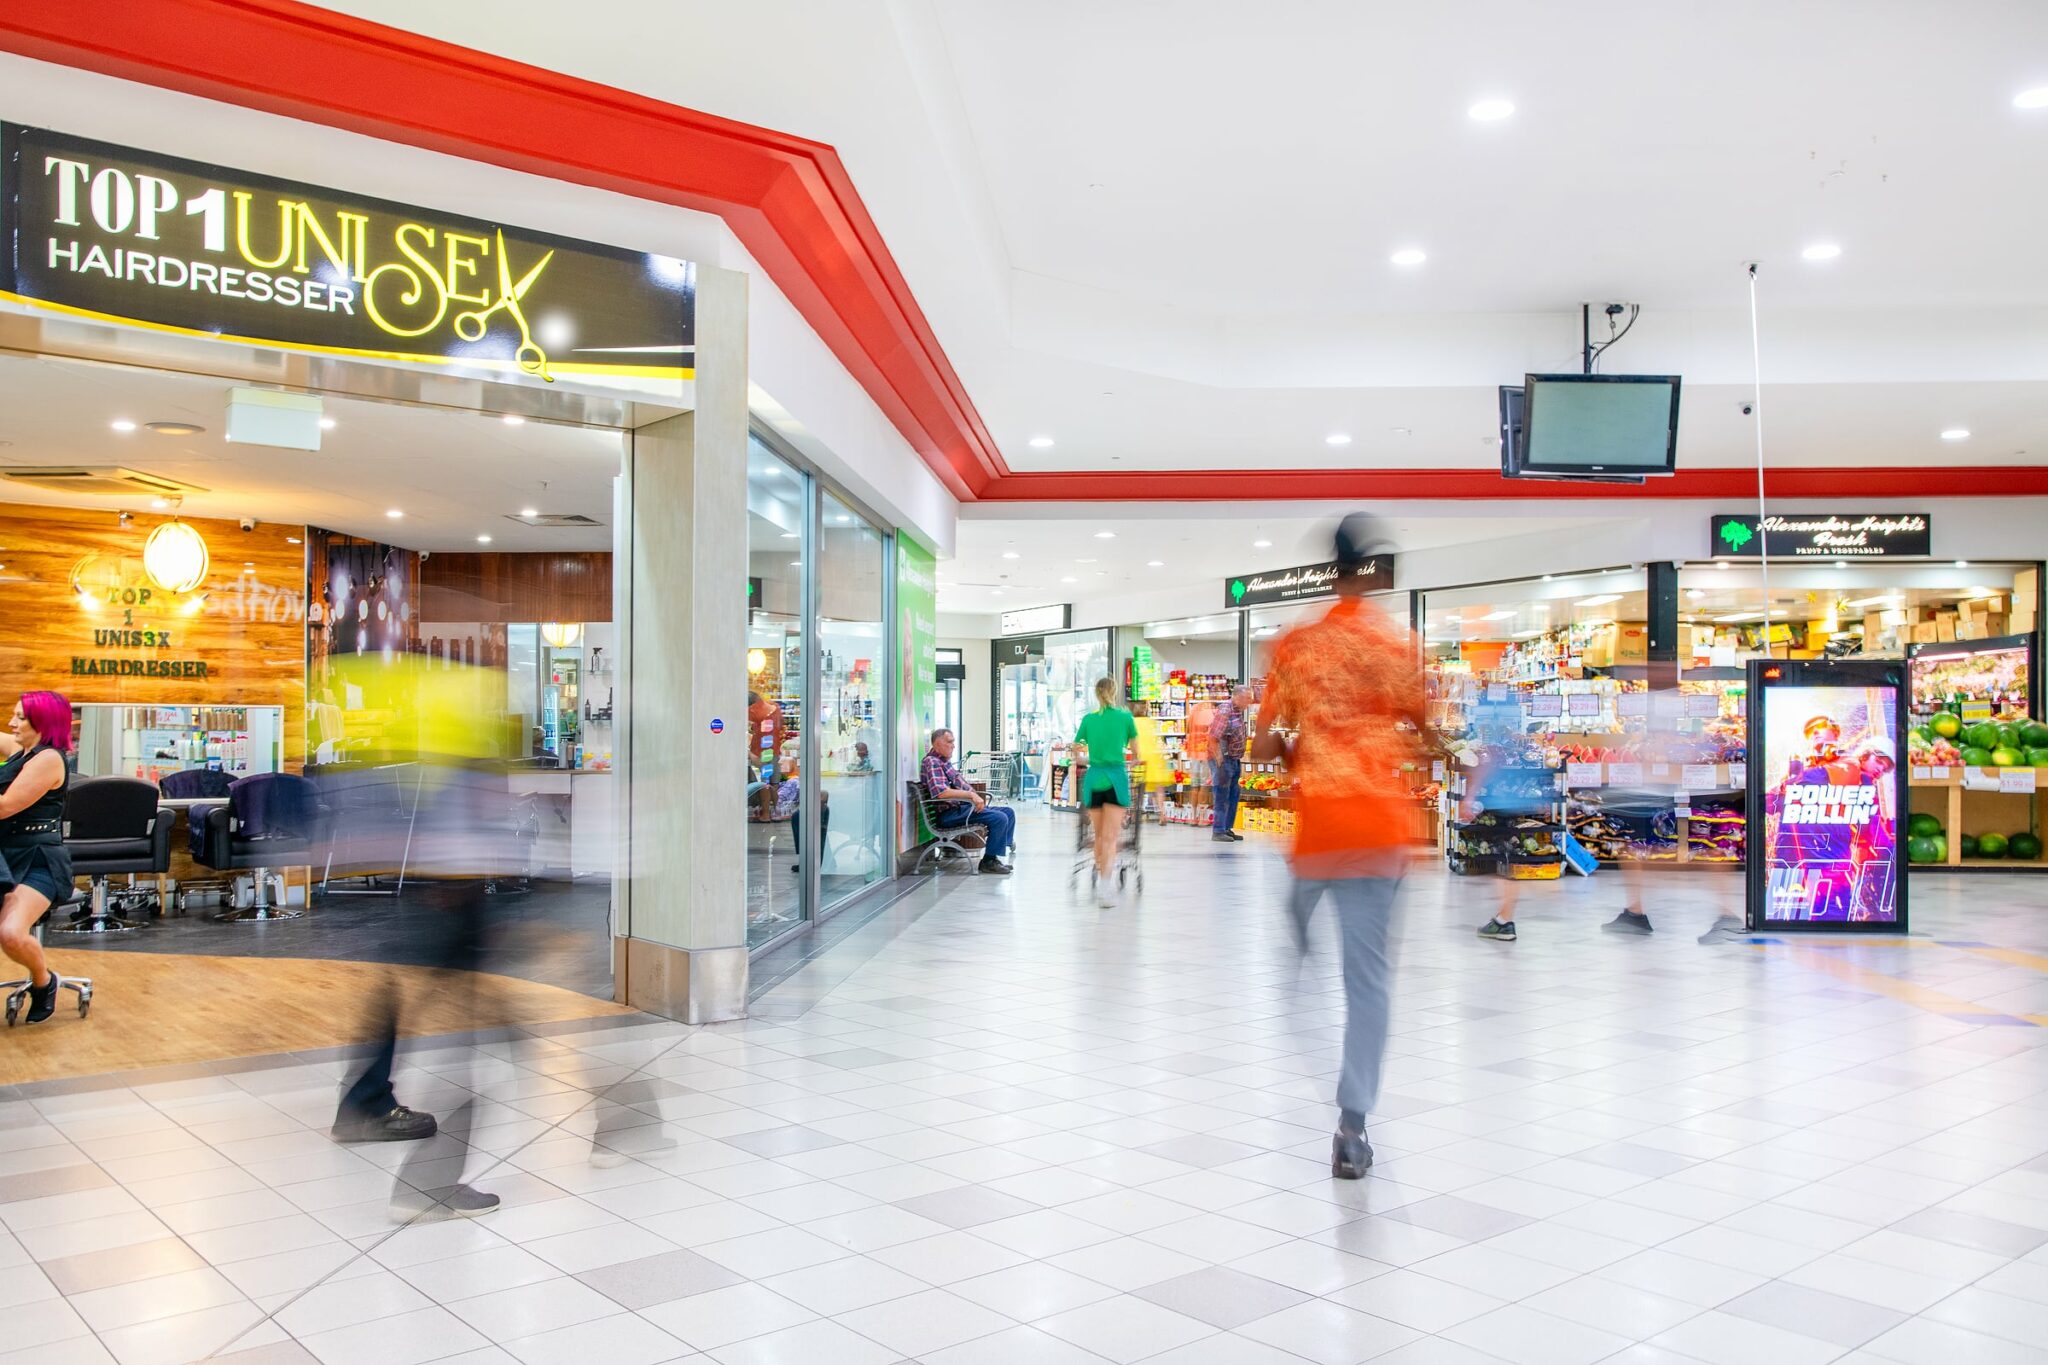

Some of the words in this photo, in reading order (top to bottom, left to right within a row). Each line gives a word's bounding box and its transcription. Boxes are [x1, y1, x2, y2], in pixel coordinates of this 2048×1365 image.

[45, 156, 179, 240] TOP
[48, 237, 356, 316] HAIRDRESSER
[1756, 516, 1850, 532] Alexander
[1851, 515, 1925, 536] Heights
[1812, 531, 1868, 547] Fresh
[1831, 547, 1885, 555] VEGETABLES
[1247, 573, 1298, 593] Alexander
[1298, 565, 1340, 586] Heights
[107, 587, 152, 606] TOP
[124, 609, 133, 626] 1
[1014, 644, 1030, 656] DLX
[71, 655, 208, 679] HAIRDRESSER
[1784, 784, 1878, 805] POWER
[1781, 804, 1878, 825] BALLIN'
